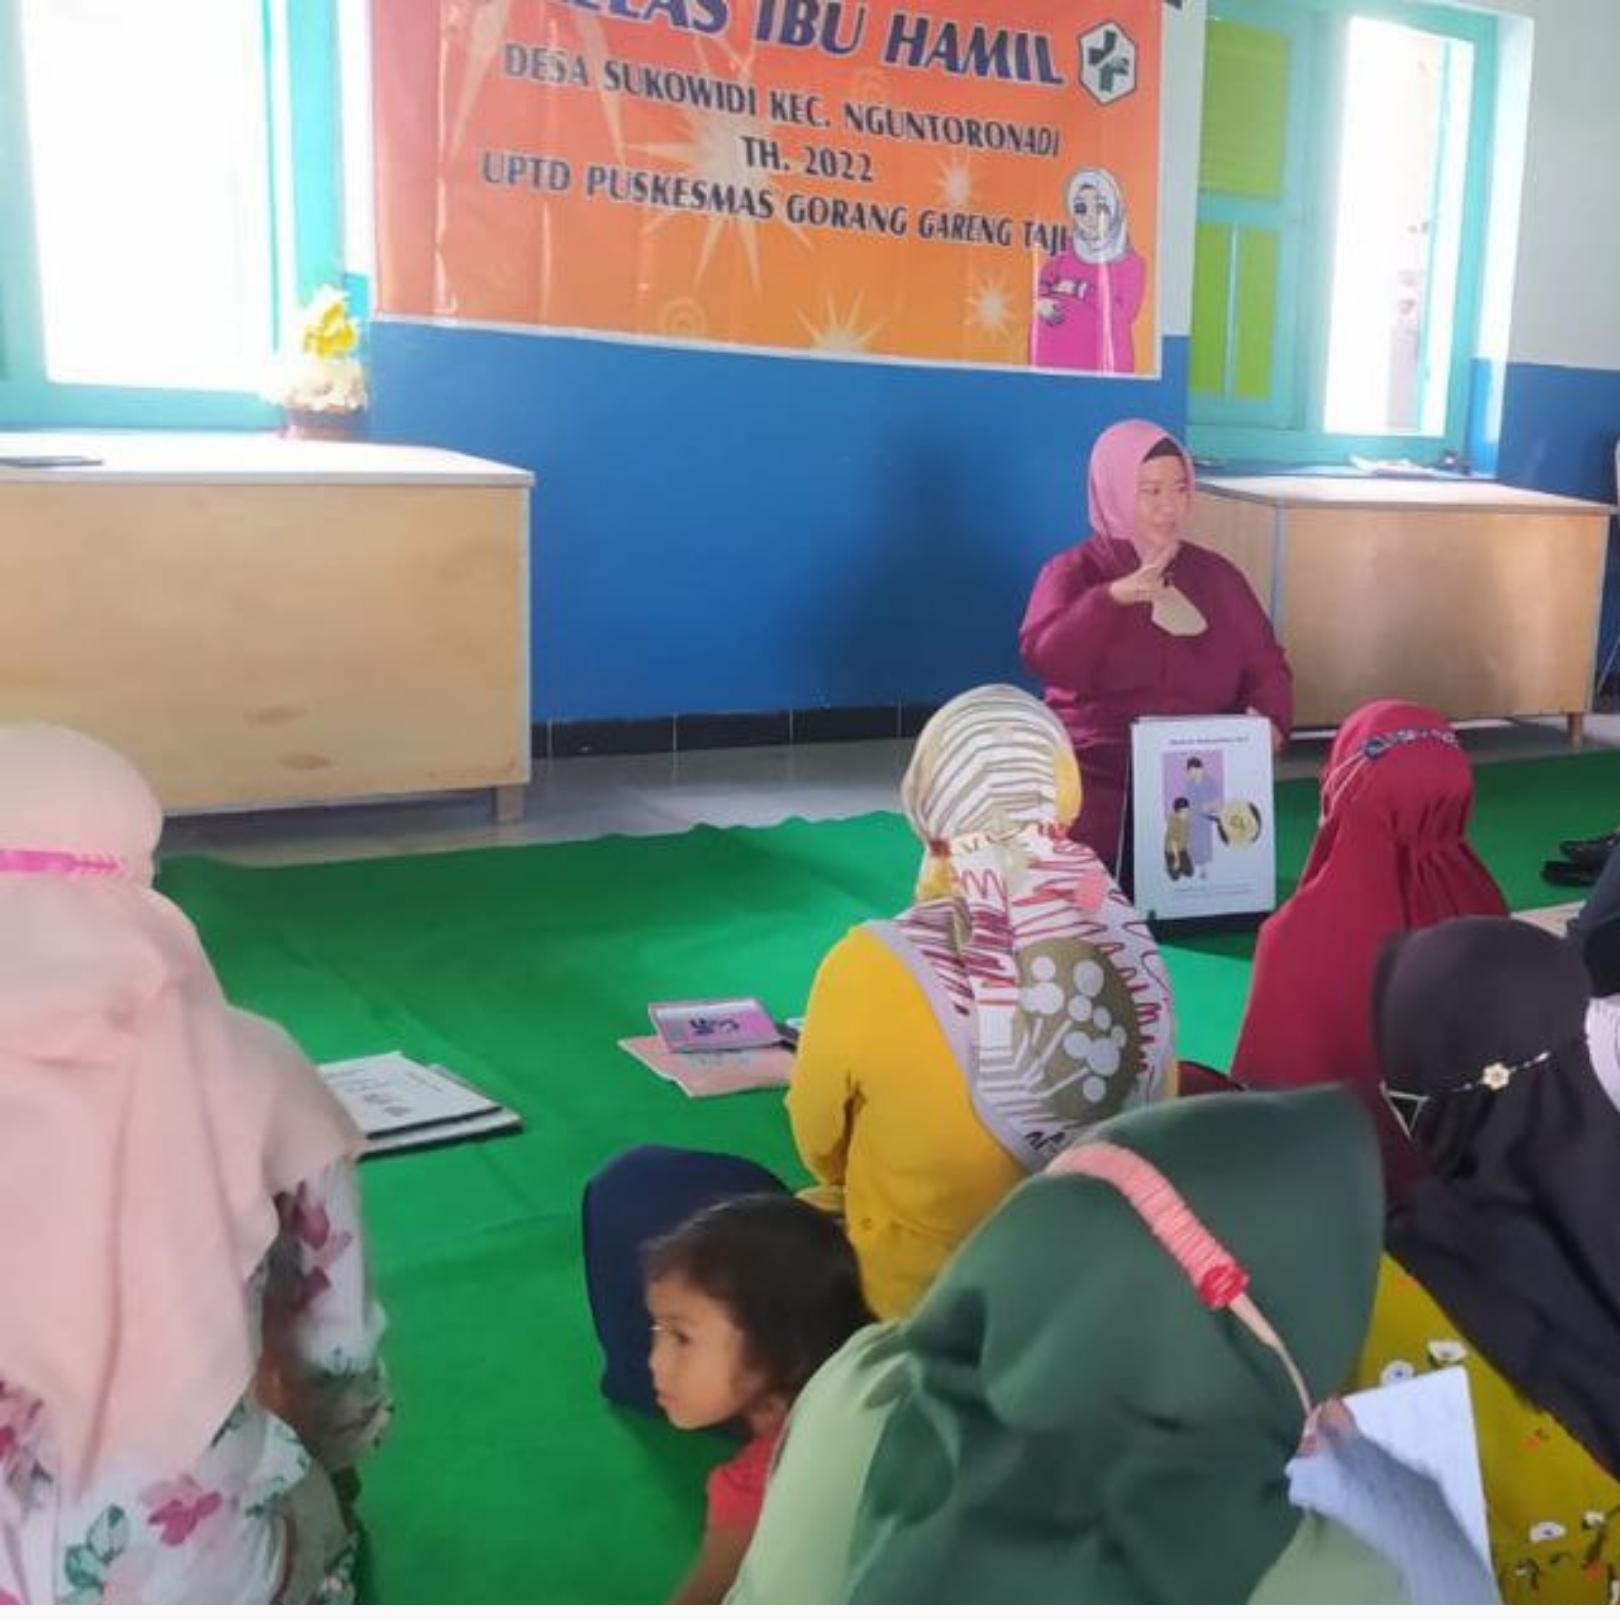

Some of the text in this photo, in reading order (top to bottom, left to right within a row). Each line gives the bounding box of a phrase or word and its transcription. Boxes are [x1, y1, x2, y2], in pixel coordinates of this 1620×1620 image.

[755, 0, 866, 54] IBU
[885, 13, 1065, 84] HAMIL
[504, 43, 1060, 157] DESA SUKOWIDI KEC. NGUNTORONADI
[482, 150, 1068, 257] UPTD PUSKESMAS GORANG GARENG TAJI
[741, 136, 873, 183] TH. 2022
